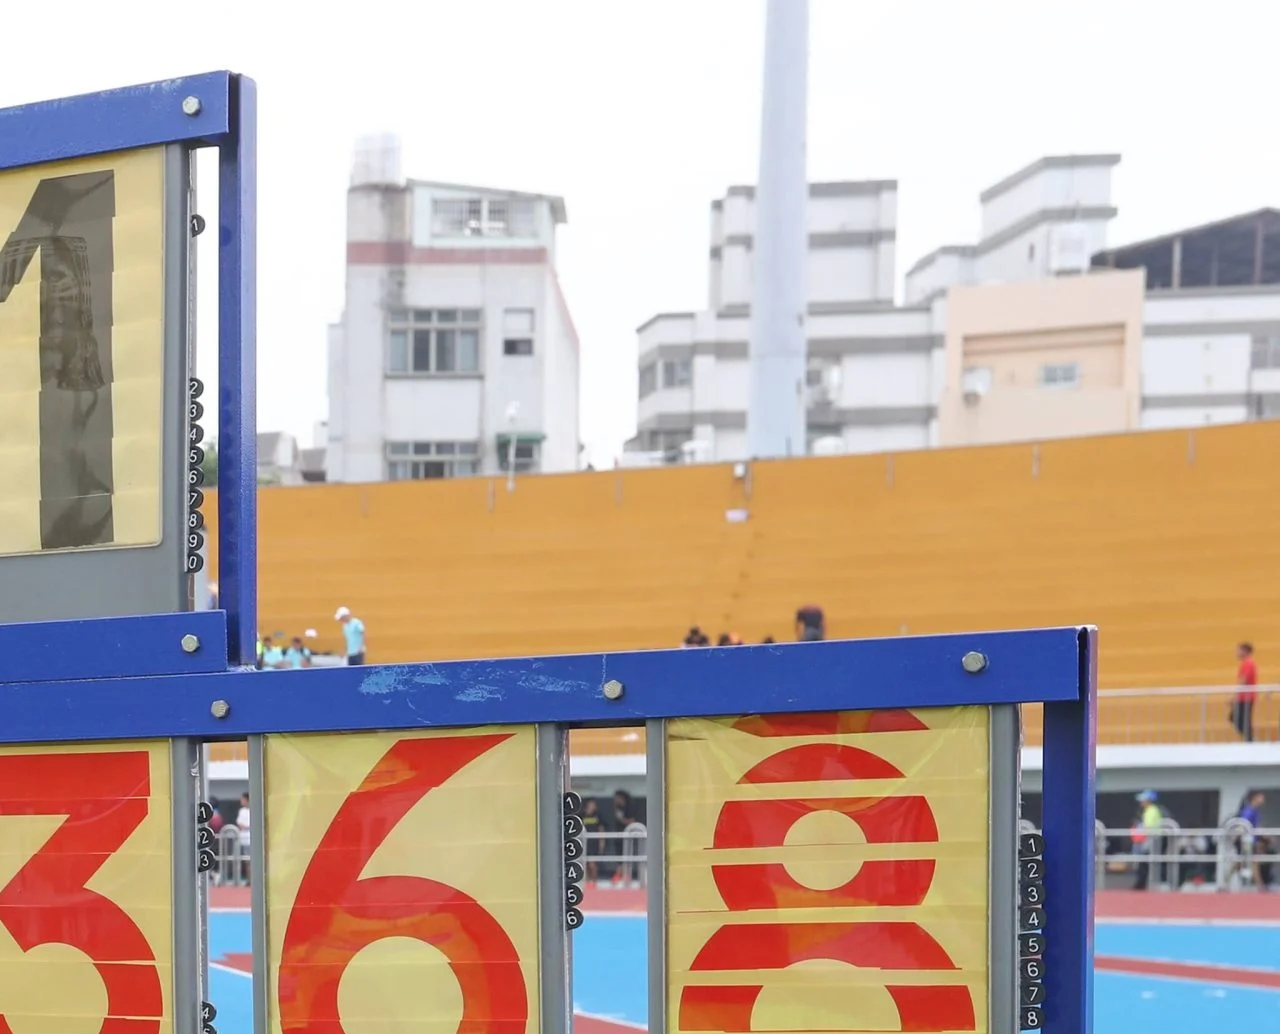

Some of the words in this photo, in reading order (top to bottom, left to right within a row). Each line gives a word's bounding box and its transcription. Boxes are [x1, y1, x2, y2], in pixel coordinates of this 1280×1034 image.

[192, 218, 198, 231] 1
[190, 382, 197, 394] 2
[190, 404, 197, 417] 3
[190, 428, 196, 440] 4
[190, 450, 197, 462] 5
[190, 471, 197, 483] 6
[190, 493, 197, 505] 7
[190, 514, 197, 526] 8
[190, 534, 197, 547] 9
[189, 556, 196, 568] 0
[566, 797, 573, 808] 1
[200, 808, 206, 818] 1
[566, 820, 576, 833] 2
[200, 831, 208, 844] 2
[566, 843, 576, 855] 3
[1029, 838, 1035, 852] 1
[200, 854, 208, 866] 3
[568, 868, 577, 878] 4
[1028, 863, 1038, 877] 2
[567, 889, 577, 902] 5
[1028, 887, 1038, 901] 3
[567, 912, 577, 924] 6
[1028, 912, 1038, 926] 4
[1029, 938, 1038, 952] 5
[1028, 963, 1038, 976] 6
[1030, 987, 1038, 1001] 7
[203, 1008, 209, 1019] 4
[1028, 1012, 1037, 1025] 8
